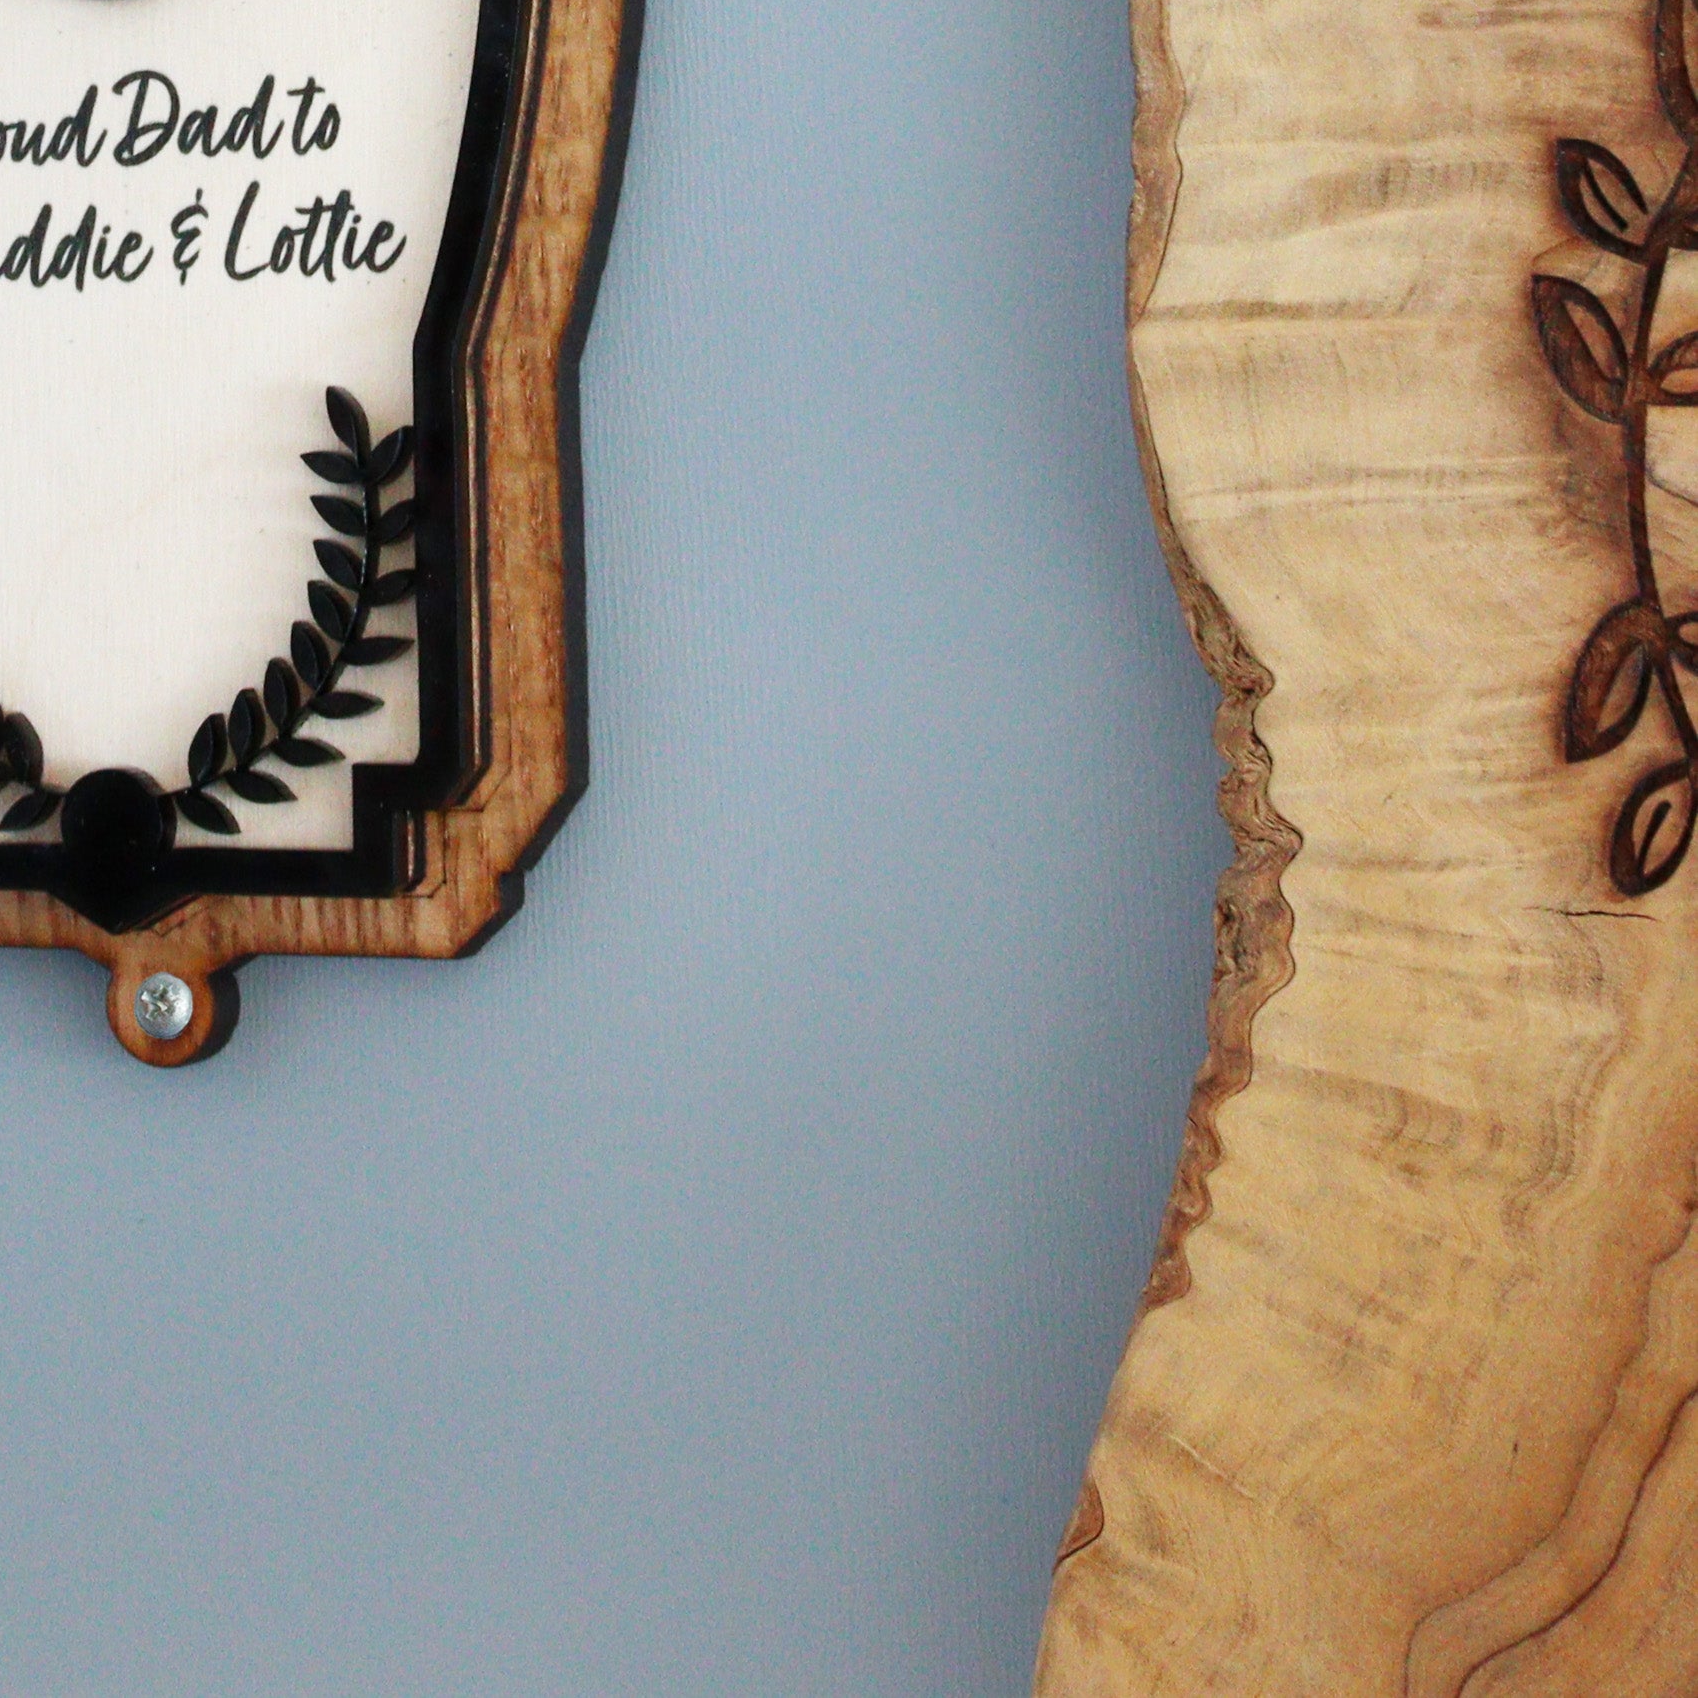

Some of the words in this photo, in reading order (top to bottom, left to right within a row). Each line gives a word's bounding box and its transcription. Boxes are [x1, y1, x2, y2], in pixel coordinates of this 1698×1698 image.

[112, 68, 285, 168] Dad
[286, 75, 343, 156] to
[169, 188, 210, 287] &
[223, 179, 409, 284] Lottie
